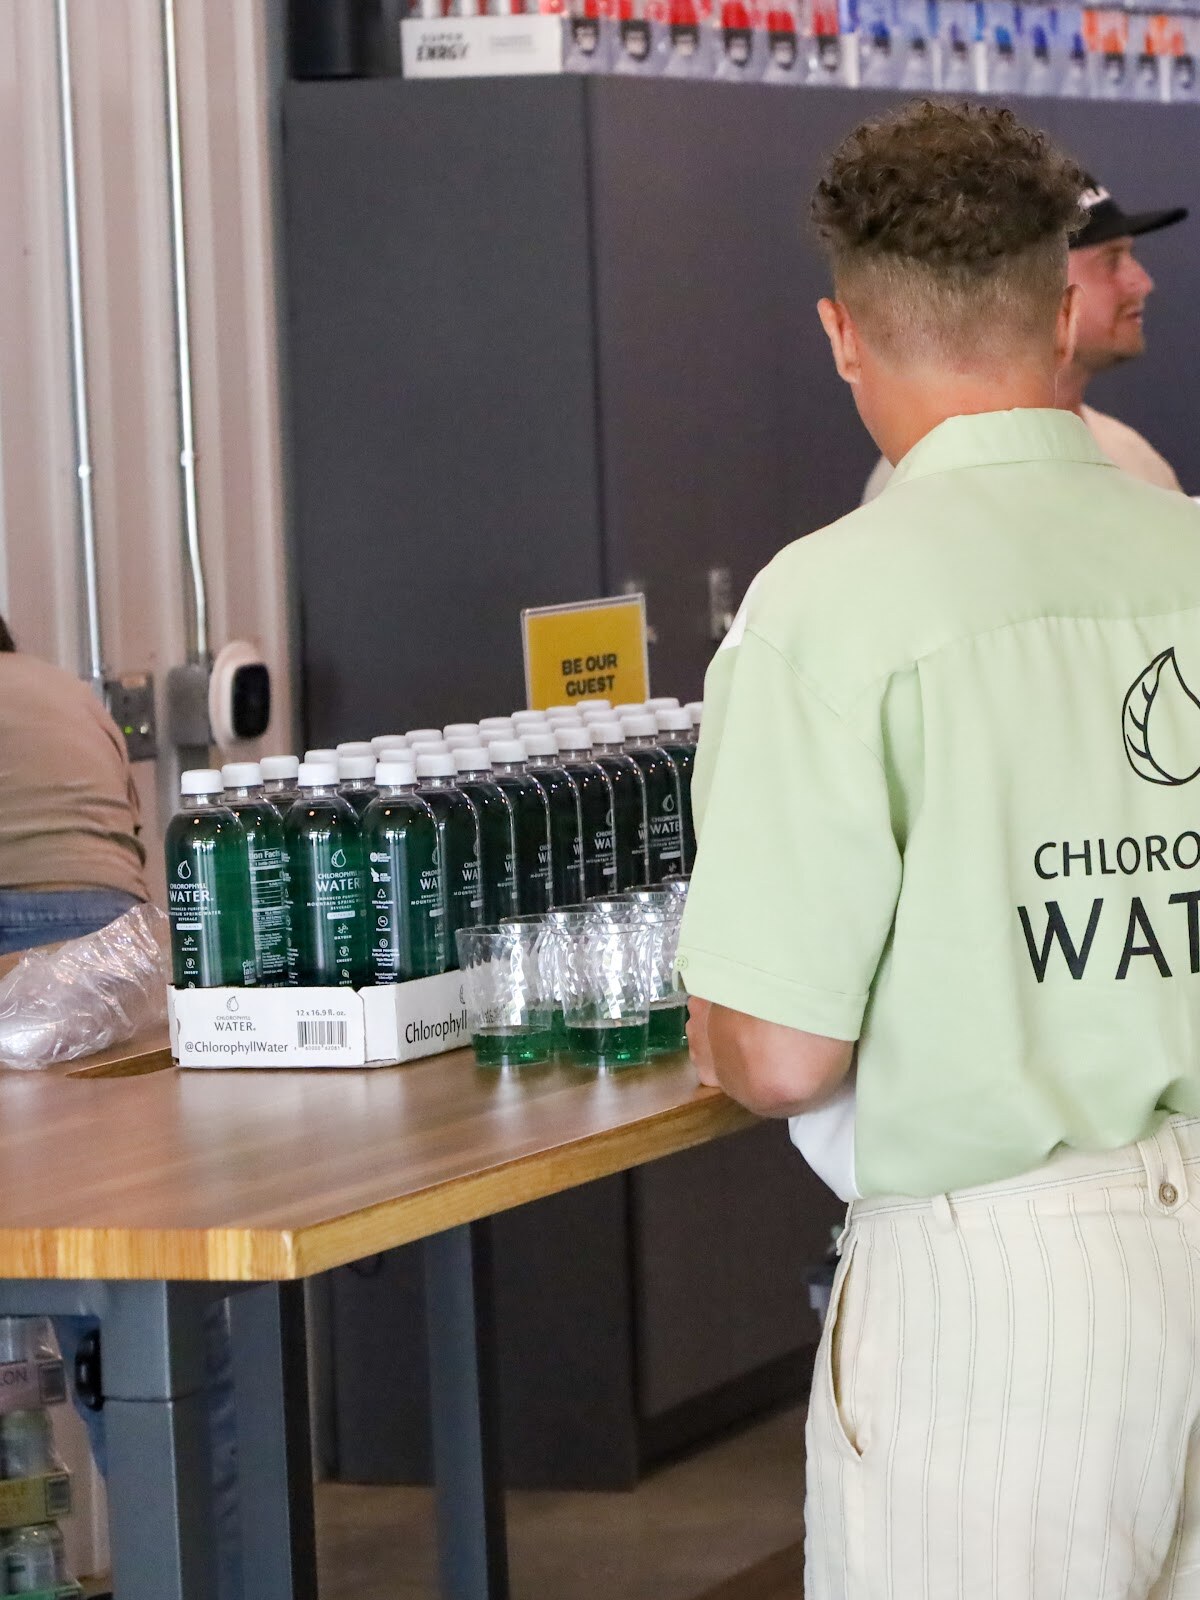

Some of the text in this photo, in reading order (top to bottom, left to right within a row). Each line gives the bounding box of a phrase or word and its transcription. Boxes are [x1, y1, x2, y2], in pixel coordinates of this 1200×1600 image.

[562, 653, 618, 676] BE OUR
[565, 675, 615, 697] GUEST
[405, 1010, 468, 1044] Chlorophyll
[184, 1041, 288, 1055] @ChlorophyllWater
